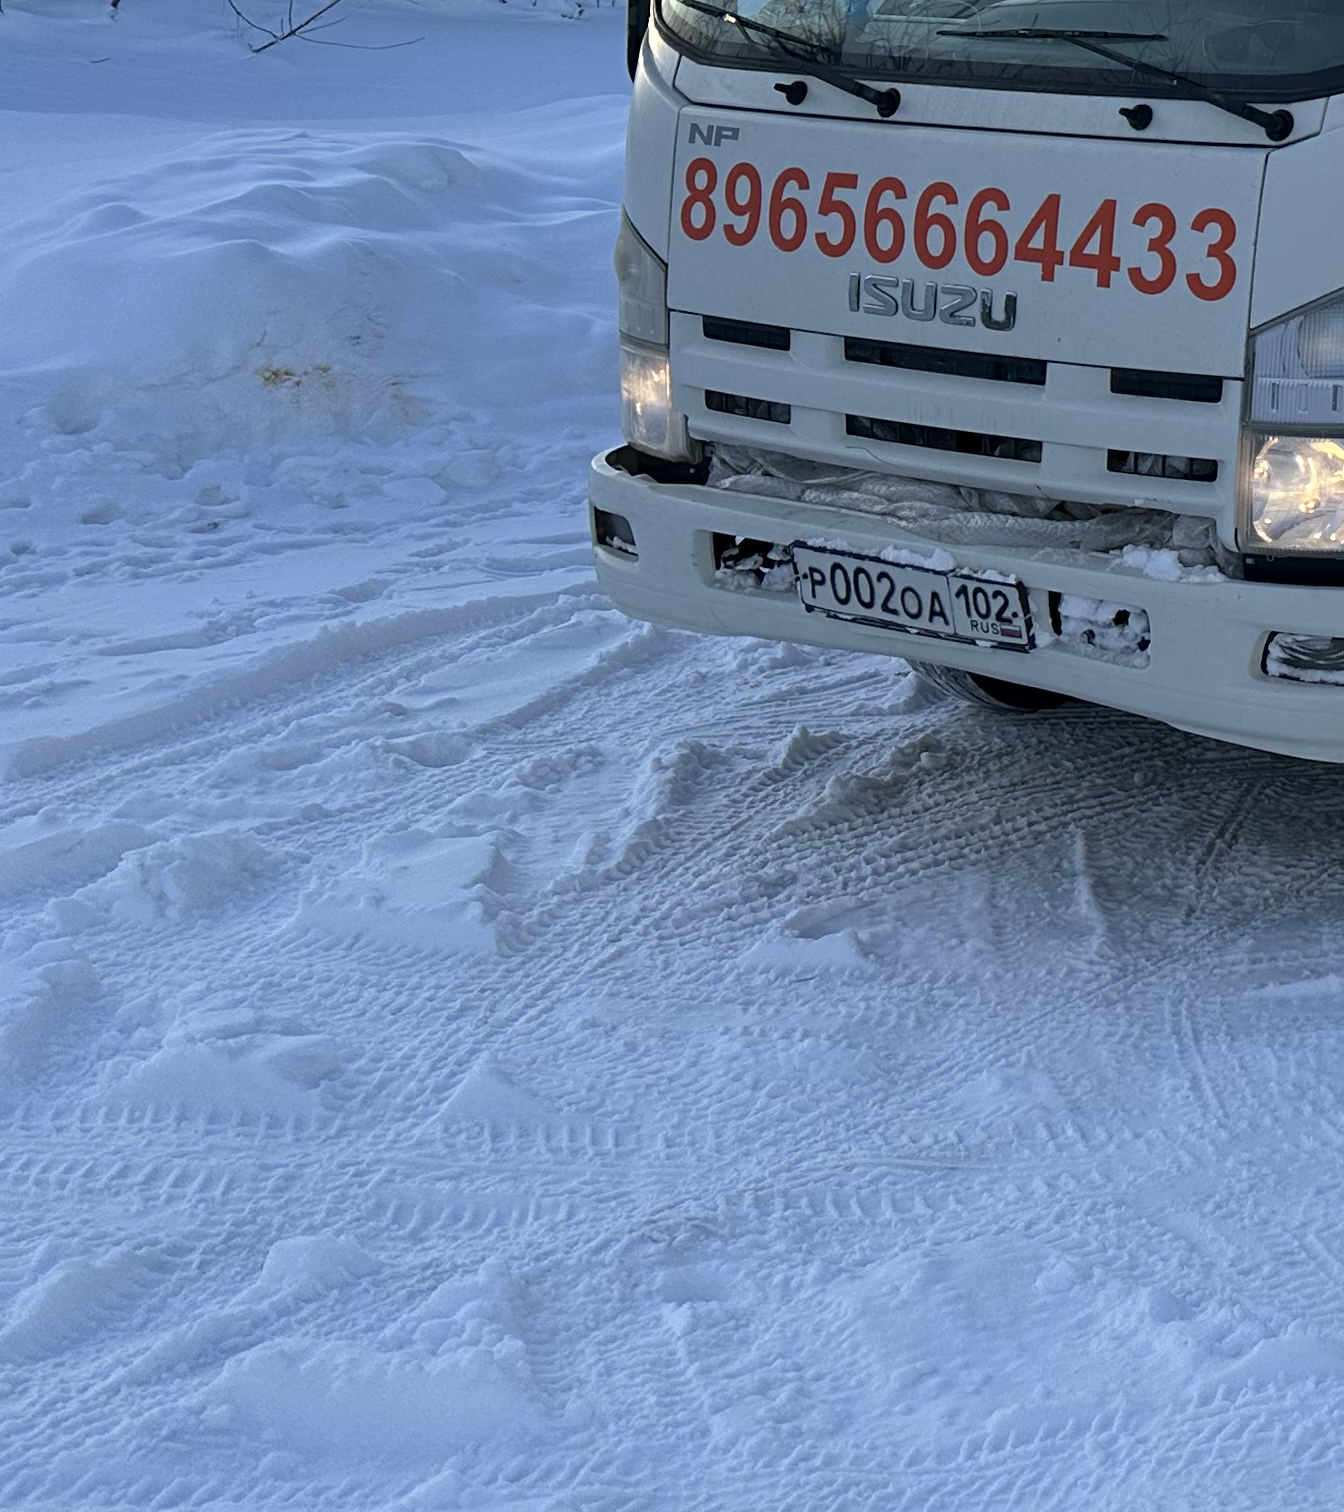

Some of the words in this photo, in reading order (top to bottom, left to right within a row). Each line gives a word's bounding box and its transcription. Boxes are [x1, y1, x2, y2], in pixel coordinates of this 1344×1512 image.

[687, 122, 740, 148] NP
[680, 157, 1238, 301] 89656664433
[848, 271, 1018, 332] ISUZU
[954, 583, 1013, 624] 102
[970, 619, 1000, 636] RUS
